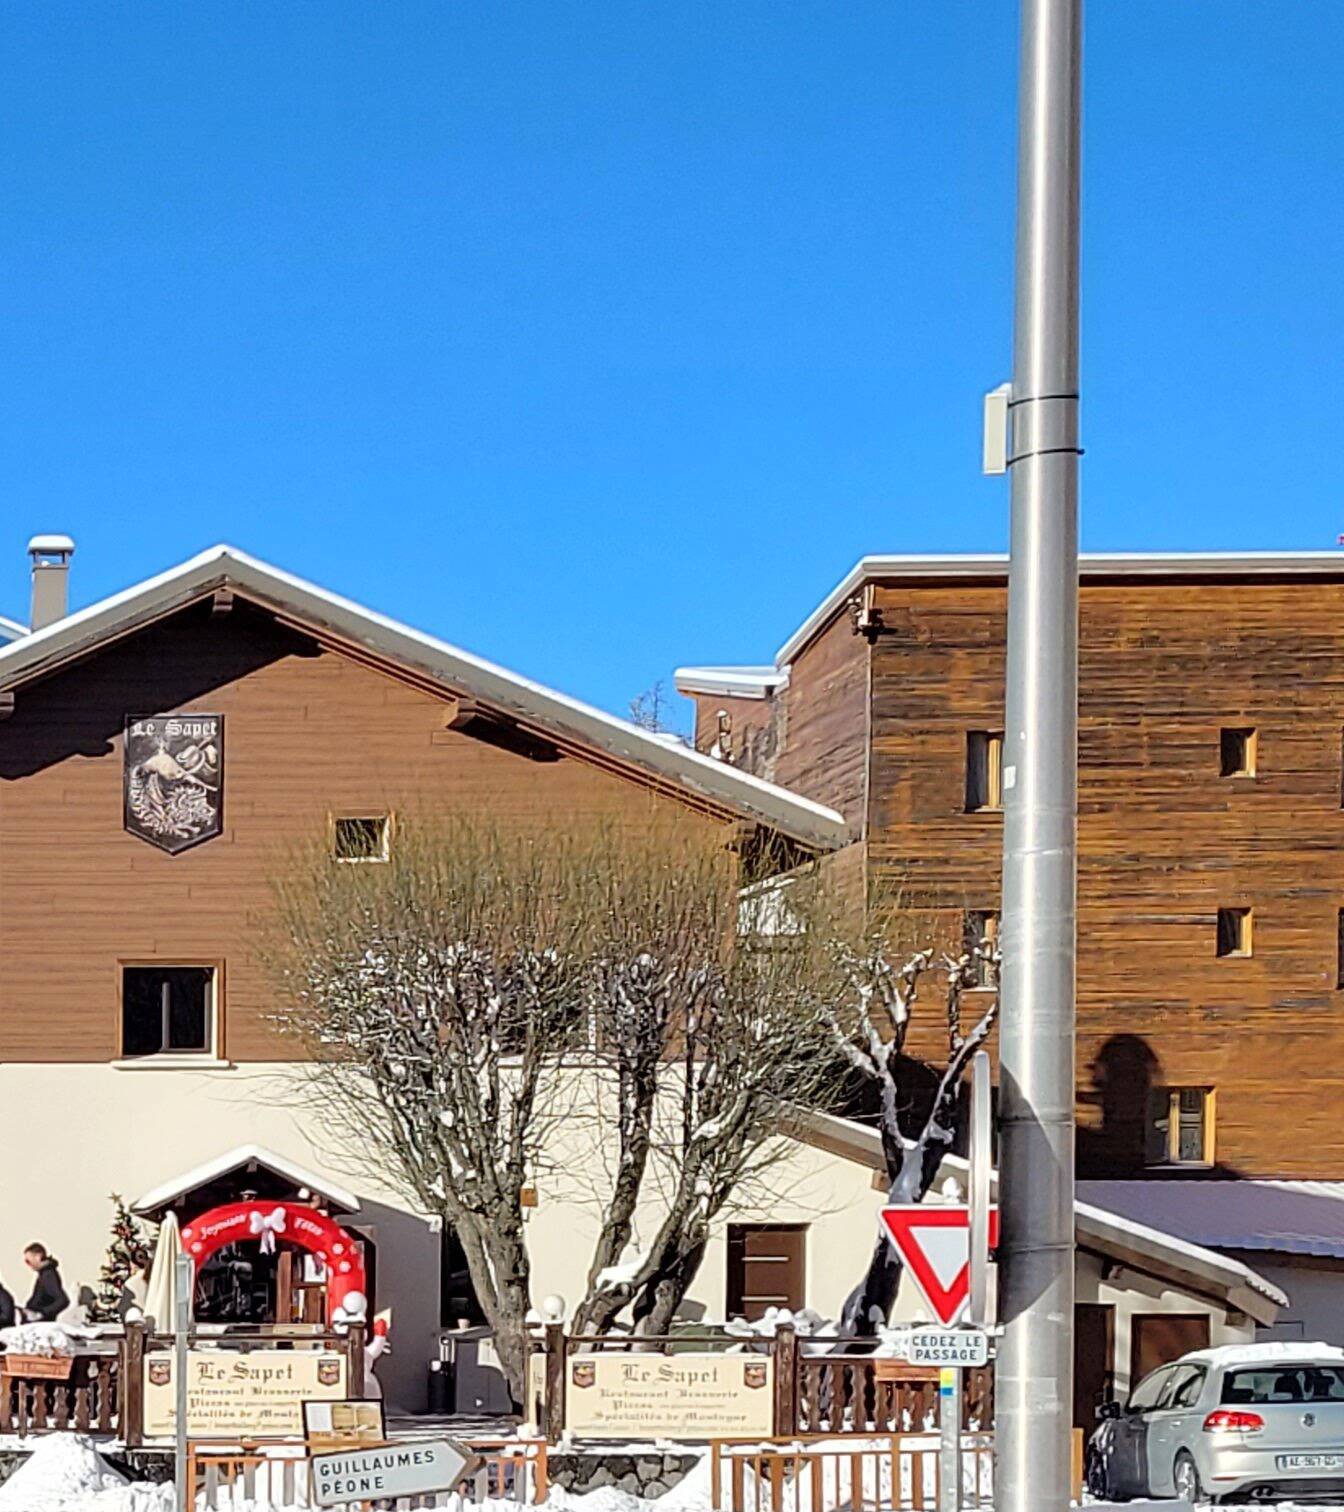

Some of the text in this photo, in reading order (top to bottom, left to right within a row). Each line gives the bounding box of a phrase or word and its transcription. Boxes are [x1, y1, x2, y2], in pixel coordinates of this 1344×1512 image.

[132, 719, 217, 740] Le Sapet
[966, 1336, 981, 1346] LE
[915, 1349, 977, 1360] PASSAGE
[196, 1360, 293, 1385] Le Sapet
[621, 1363, 719, 1387] Le Sapet
[187, 1387, 245, 1397] estaurant
[167, 1409, 236, 1419] Sécialités
[320, 1450, 435, 1476] GUILLAUMES
[321, 1476, 384, 1497] PÉONE
